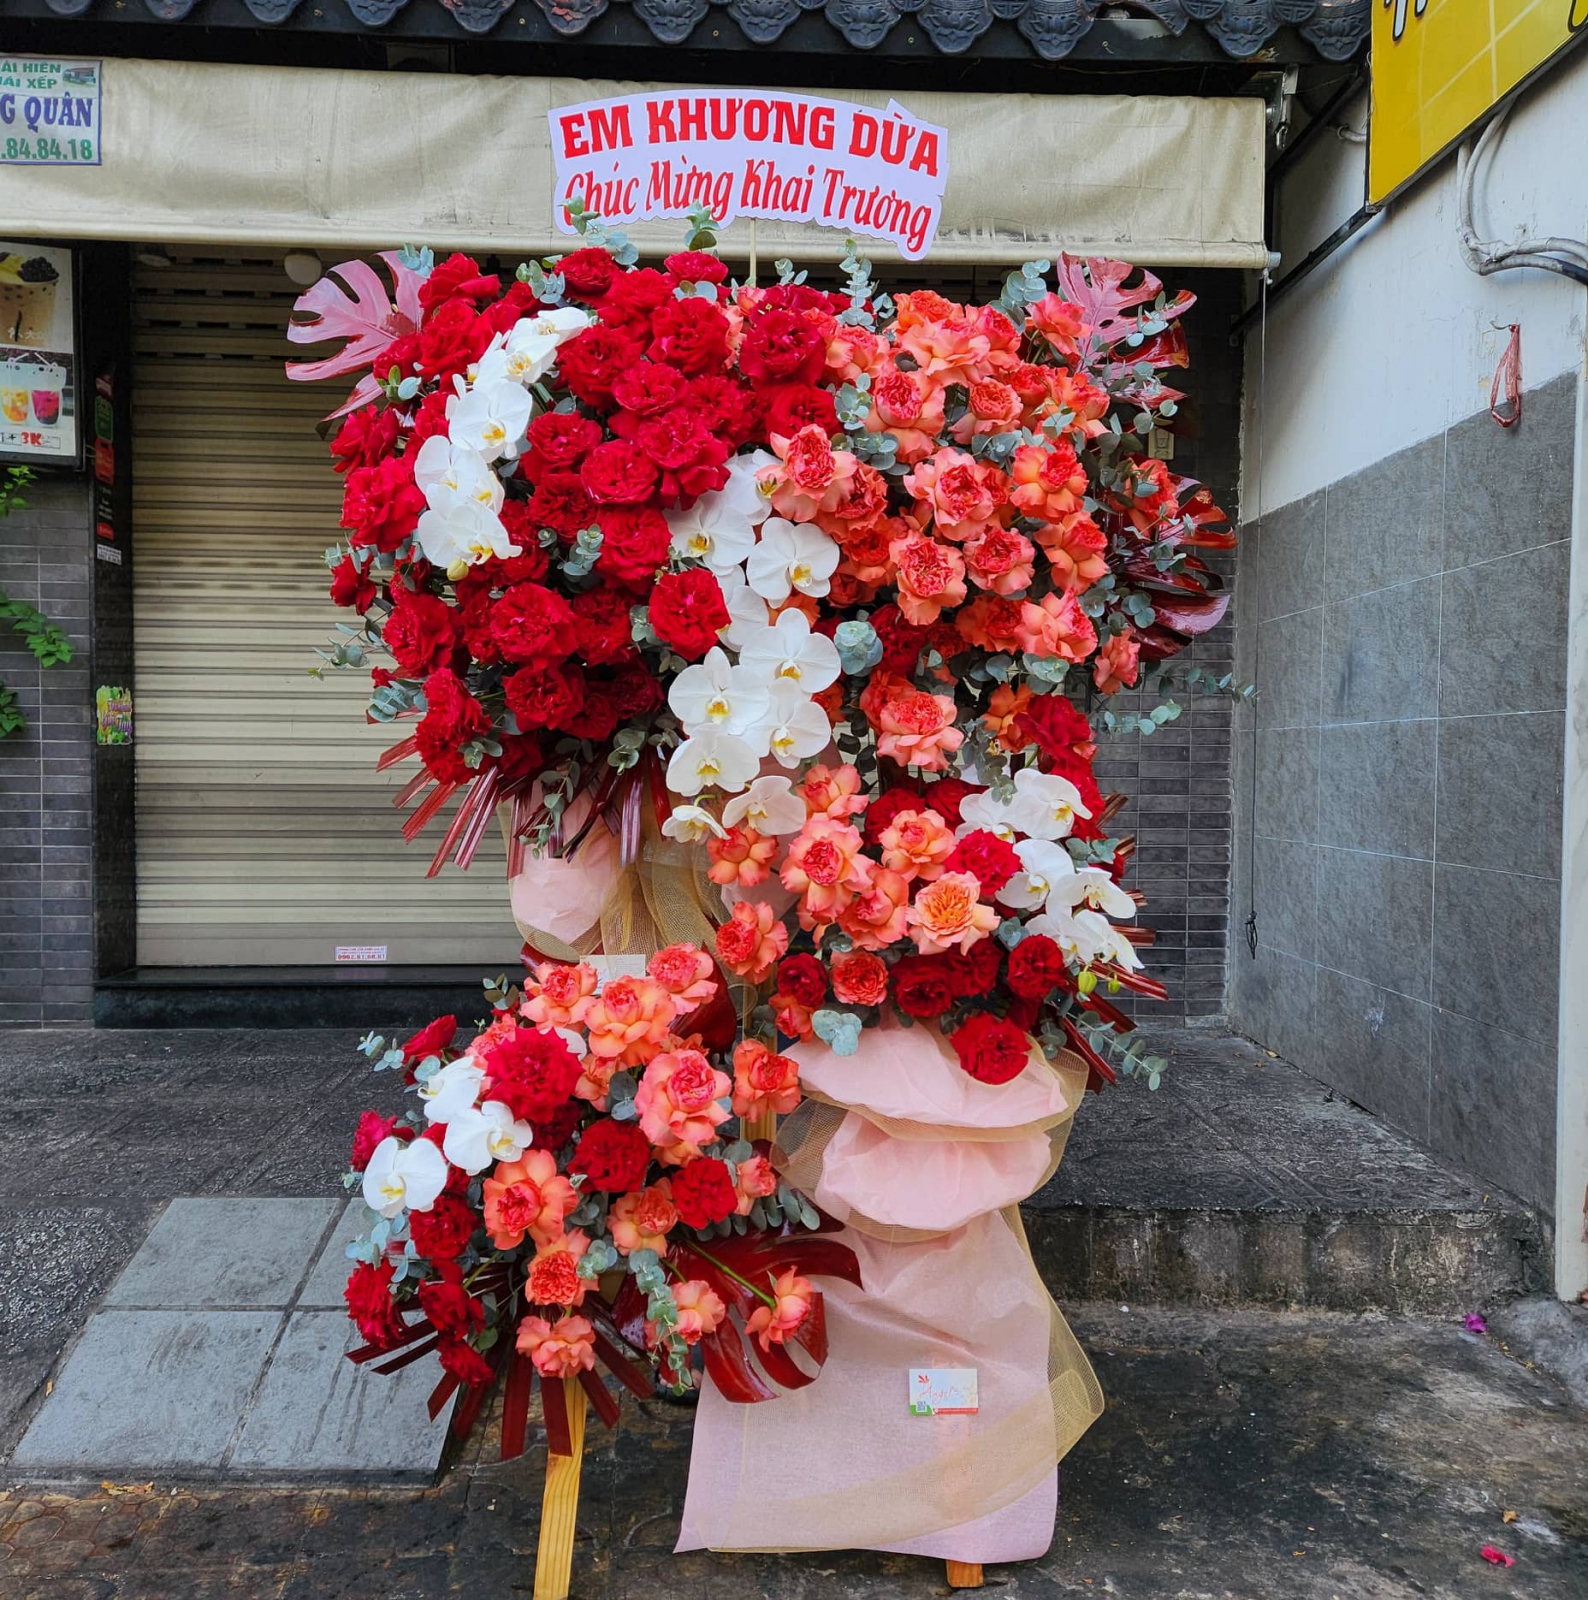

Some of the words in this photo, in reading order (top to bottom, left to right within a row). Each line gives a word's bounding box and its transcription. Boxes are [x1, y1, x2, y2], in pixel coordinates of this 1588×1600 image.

[22, 61, 62, 73] HIÊN
[26, 75, 57, 89] XẾP
[24, 91, 93, 133] QUÂN
[559, 104, 633, 159] EM
[645, 97, 835, 151] KHƯƠNG
[848, 111, 938, 178] DỪA
[562, 161, 640, 226] Chúc
[645, 154, 734, 222] Mừng
[740, 158, 815, 214] Khai
[822, 167, 932, 253] Trương
